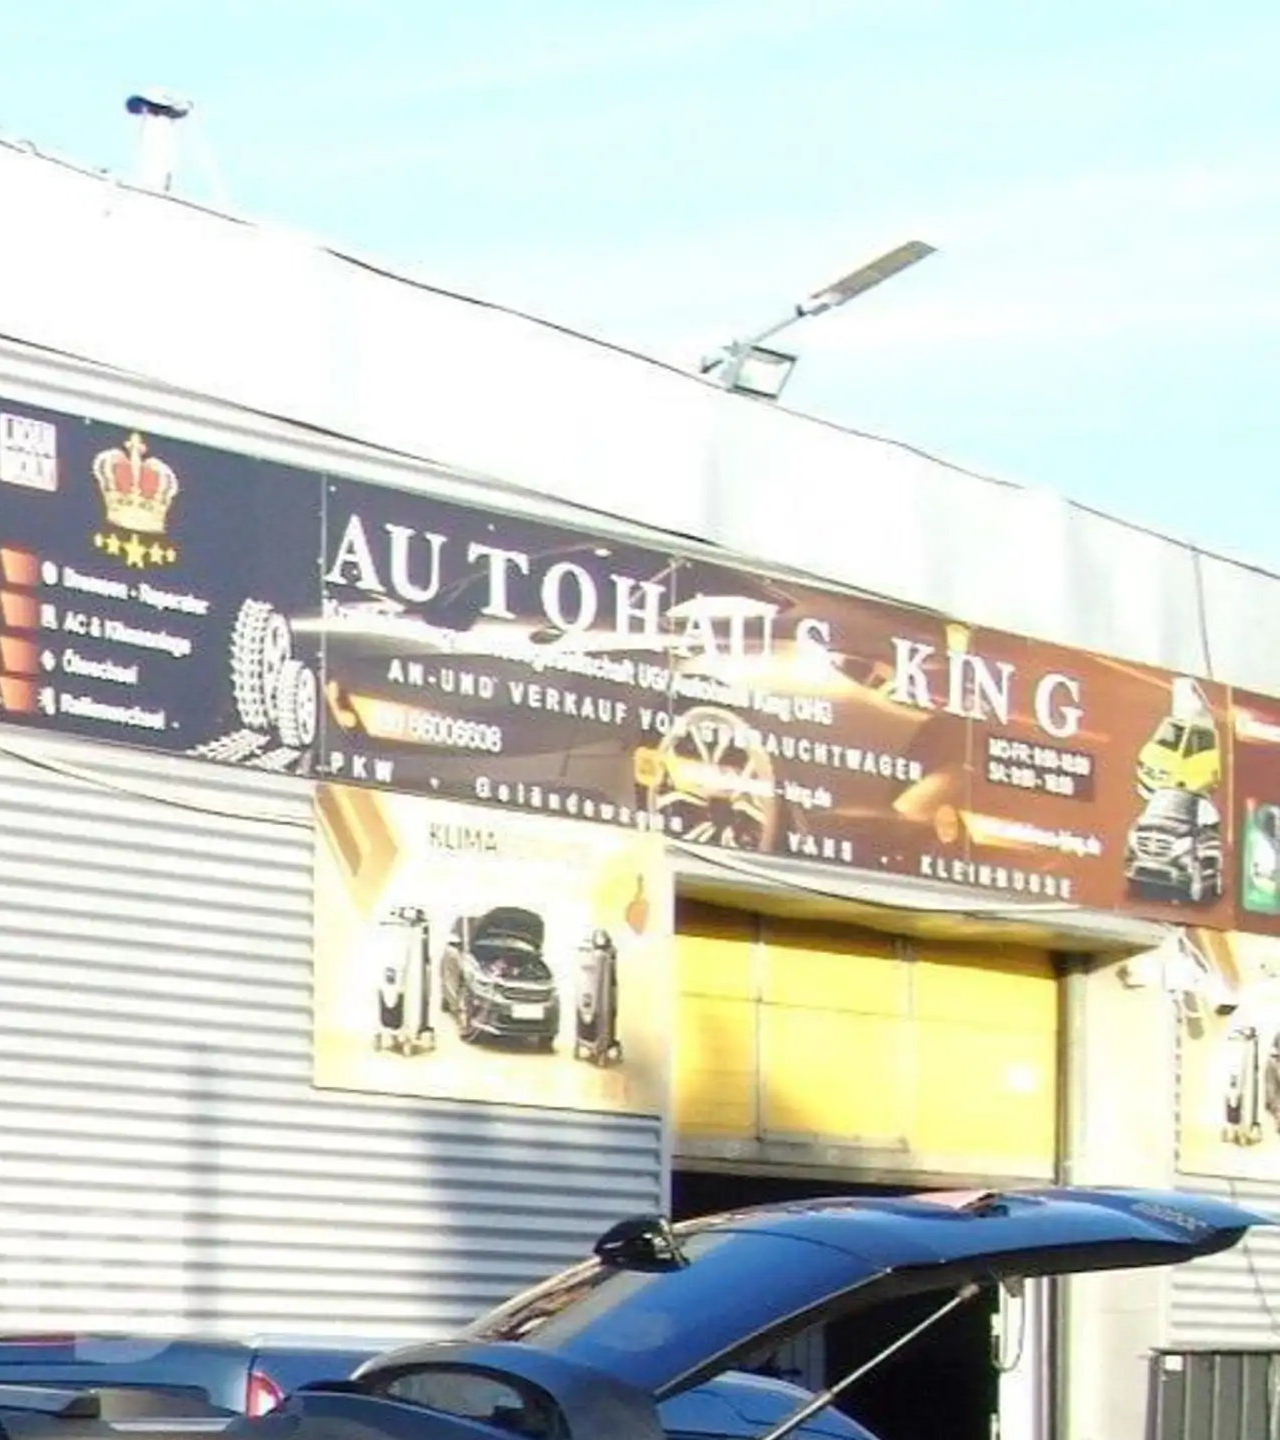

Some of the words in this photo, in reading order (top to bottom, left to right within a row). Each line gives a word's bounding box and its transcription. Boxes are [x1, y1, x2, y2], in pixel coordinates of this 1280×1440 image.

[325, 513, 832, 680] AUTOHAUS
[890, 636, 1084, 738] KING
[387, 657, 497, 699] AN-UND
[508, 682, 630, 725] VERKAUF
